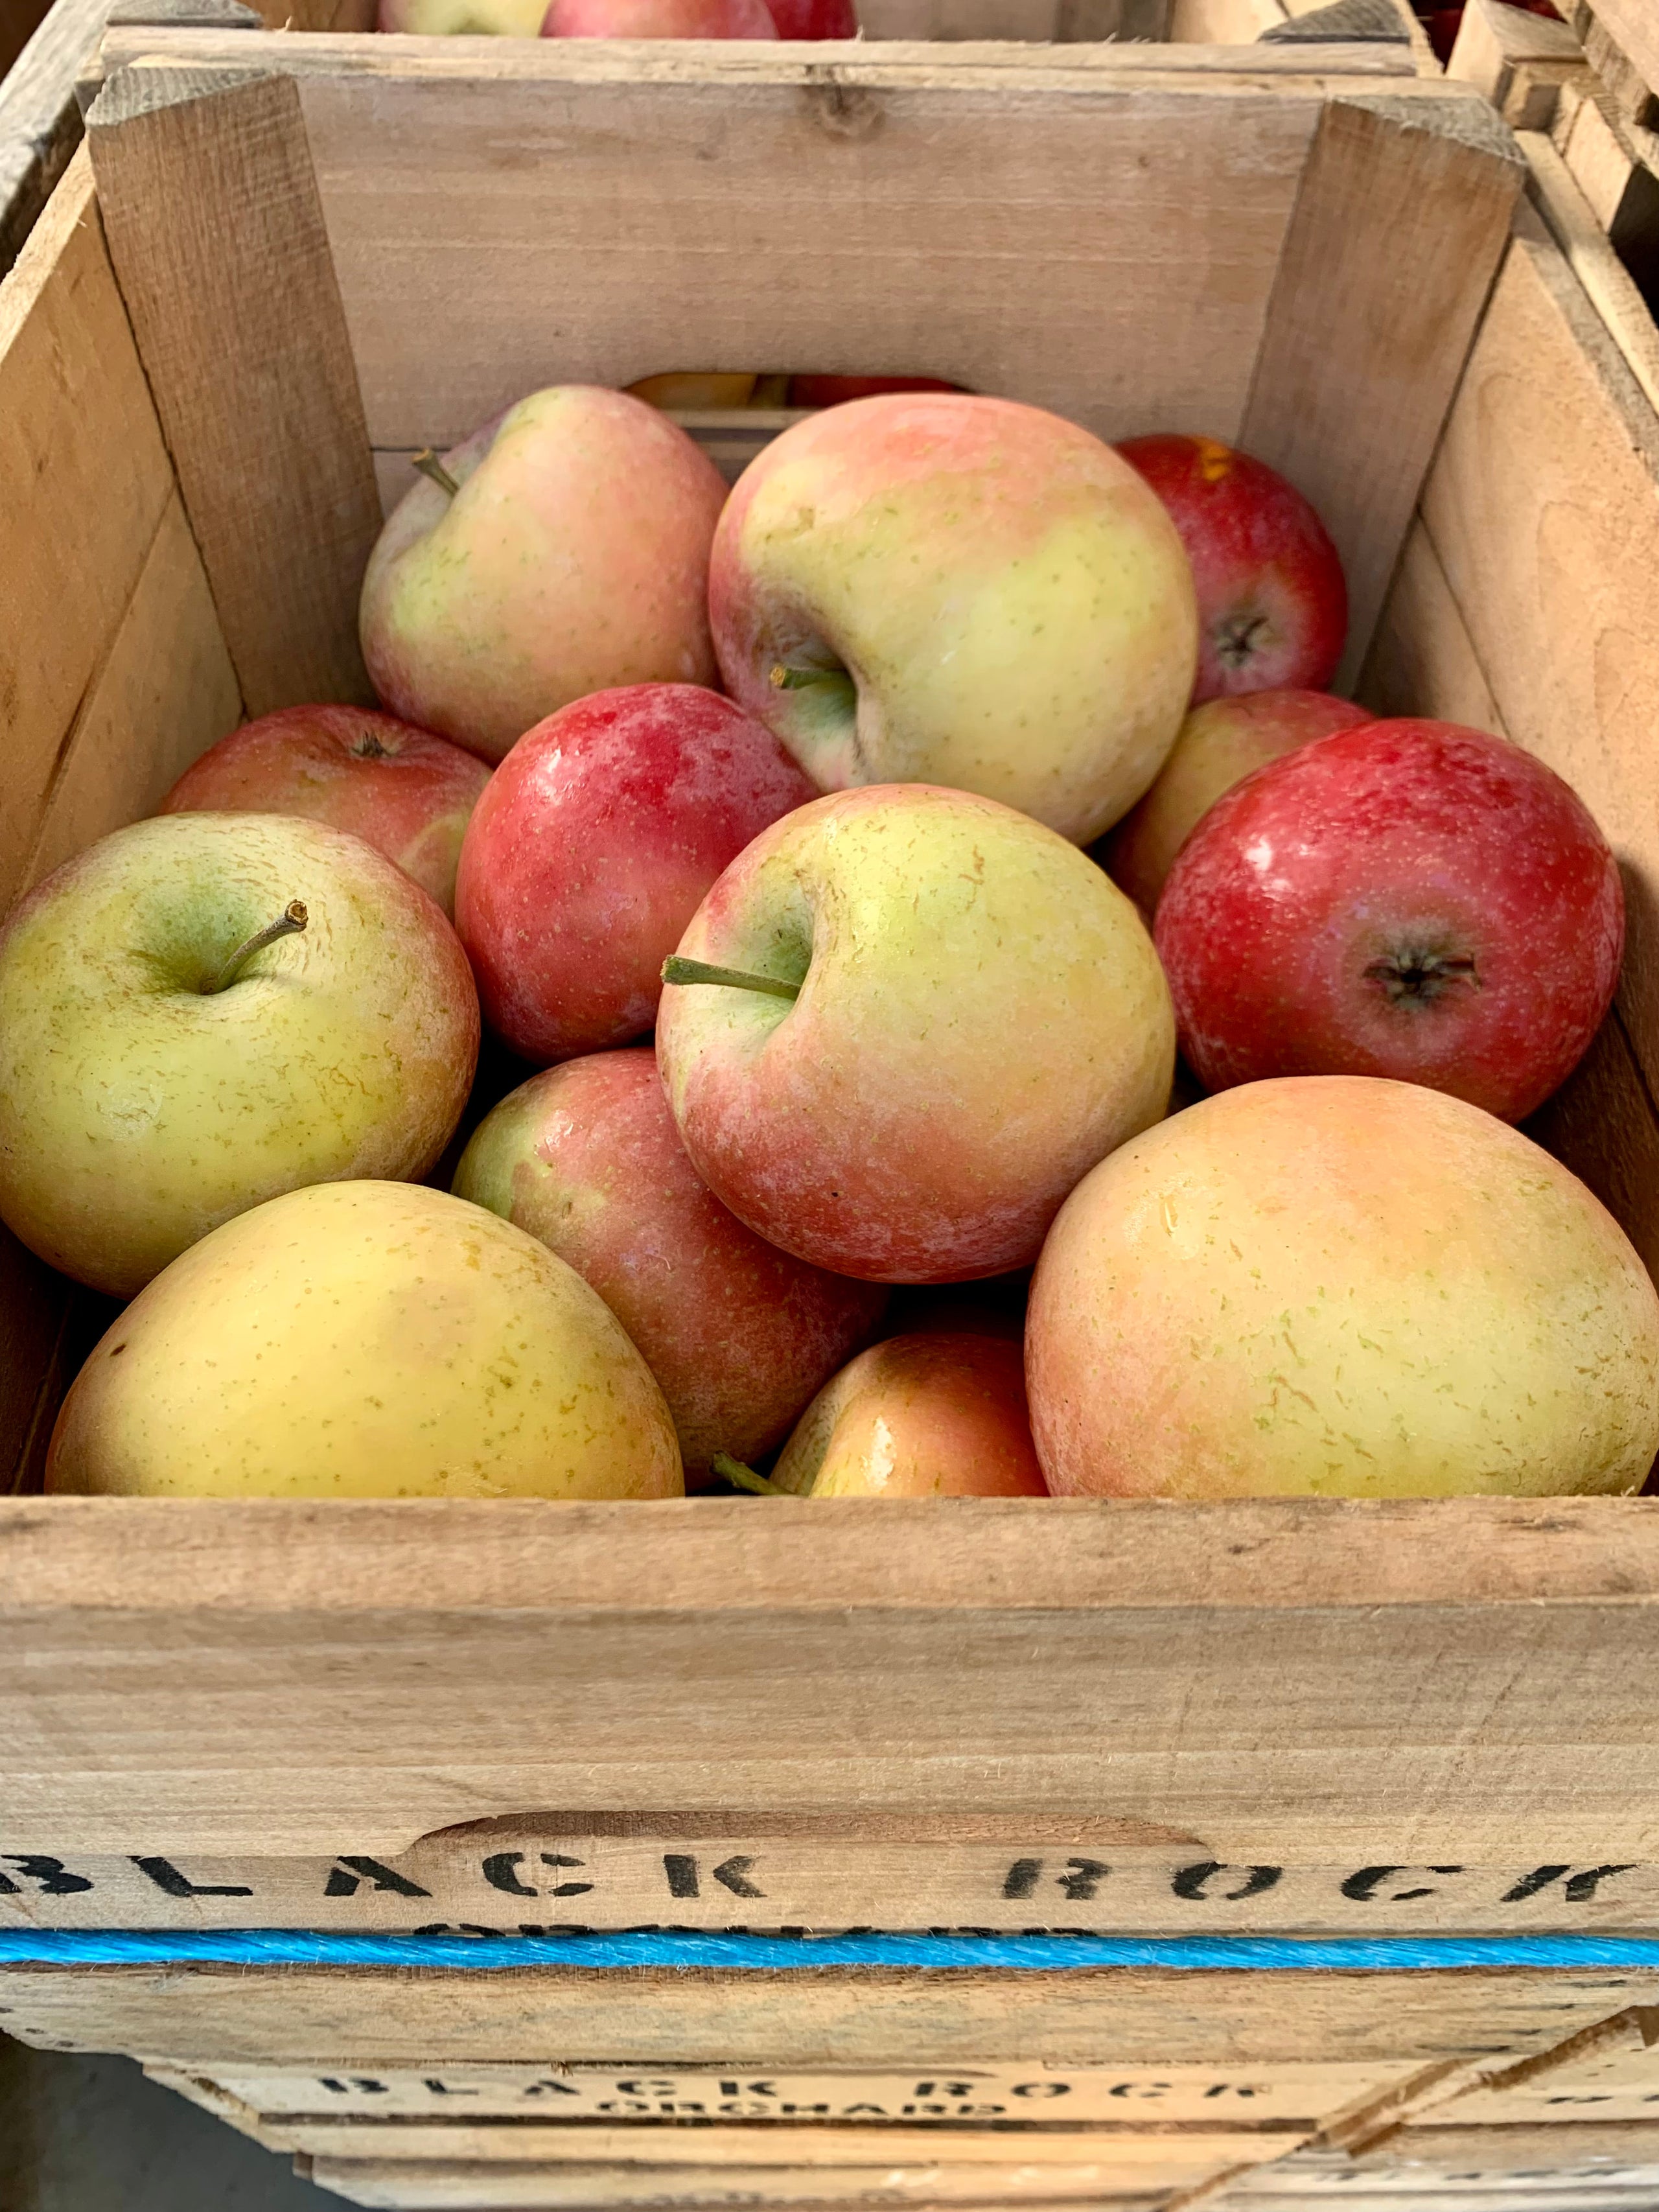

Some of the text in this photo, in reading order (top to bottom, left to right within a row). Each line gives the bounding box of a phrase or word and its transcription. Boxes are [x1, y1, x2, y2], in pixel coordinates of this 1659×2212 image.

[0, 1852, 1640, 1902] BLACK ROCK
[317, 2078, 778, 2097] BLACK
[596, 2099, 1006, 2115] ORCHARD
